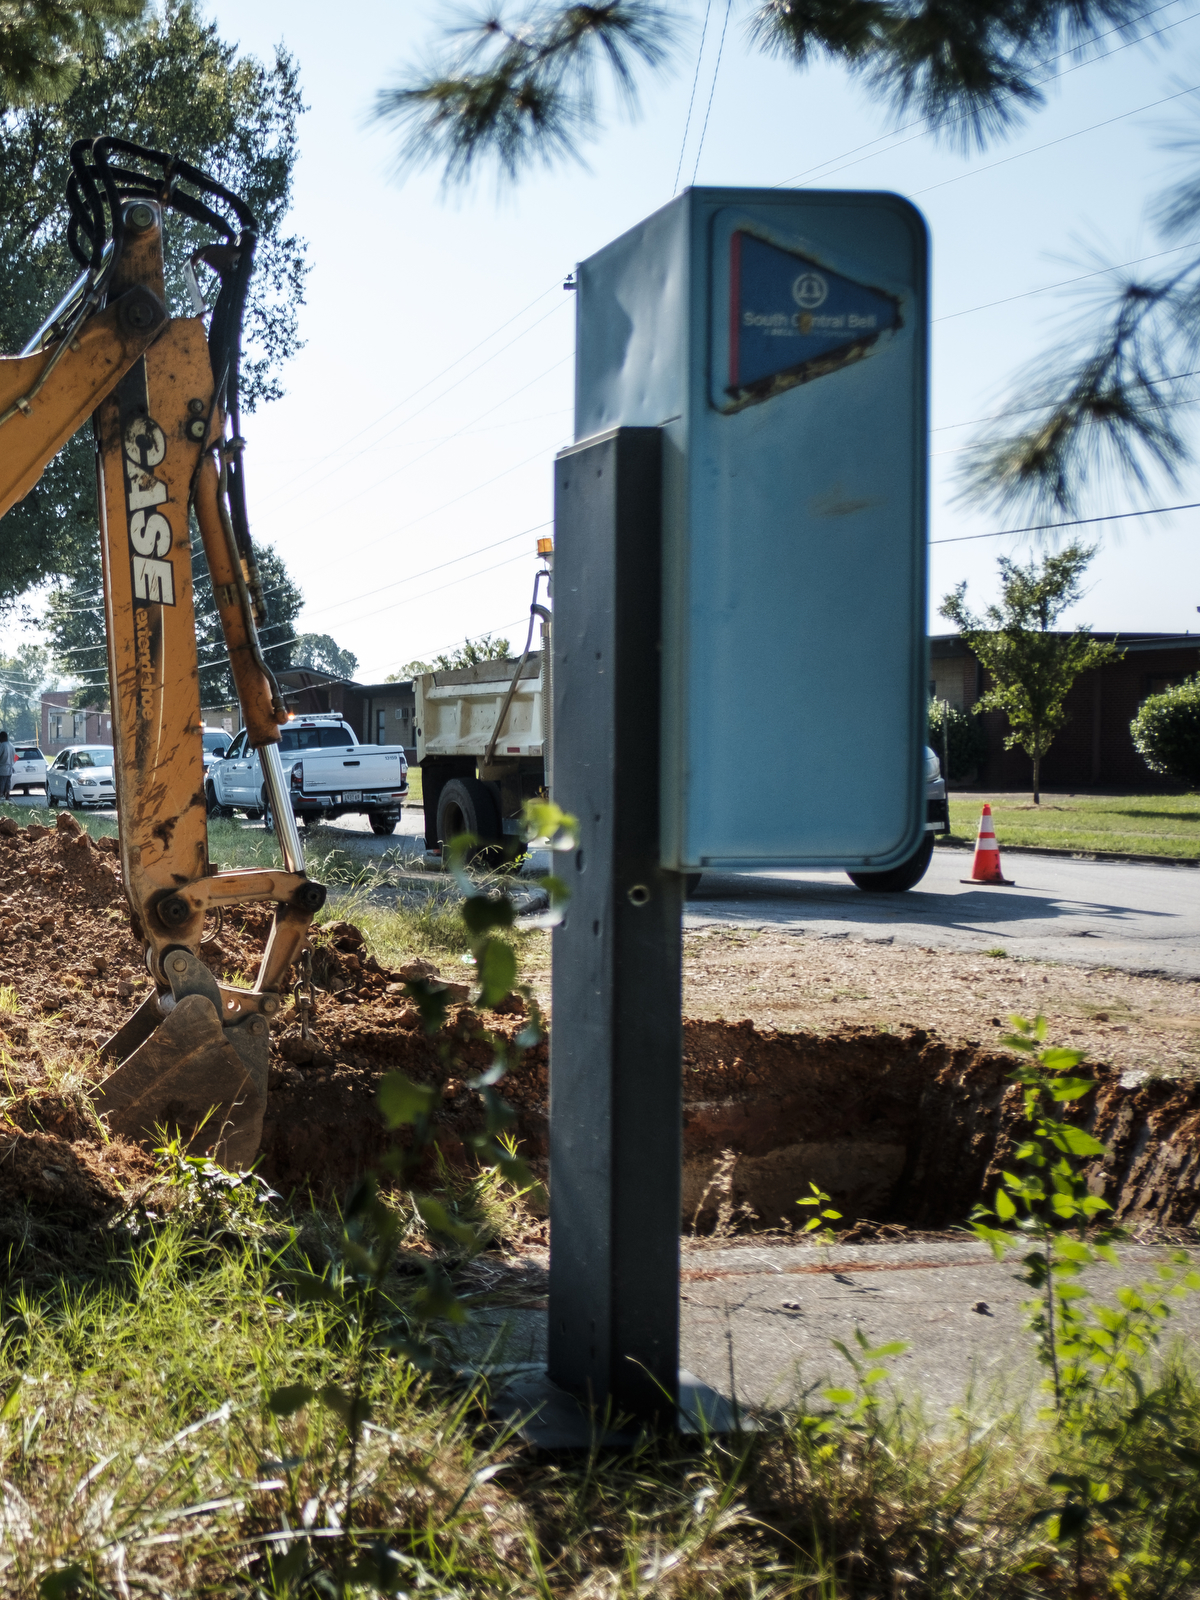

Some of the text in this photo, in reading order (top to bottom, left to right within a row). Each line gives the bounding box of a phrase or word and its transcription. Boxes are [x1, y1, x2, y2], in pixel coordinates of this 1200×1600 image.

[743, 311, 877, 328] South Cntral Bell
[124, 417, 174, 605] CASE
[135, 608, 157, 721] extendahoe
